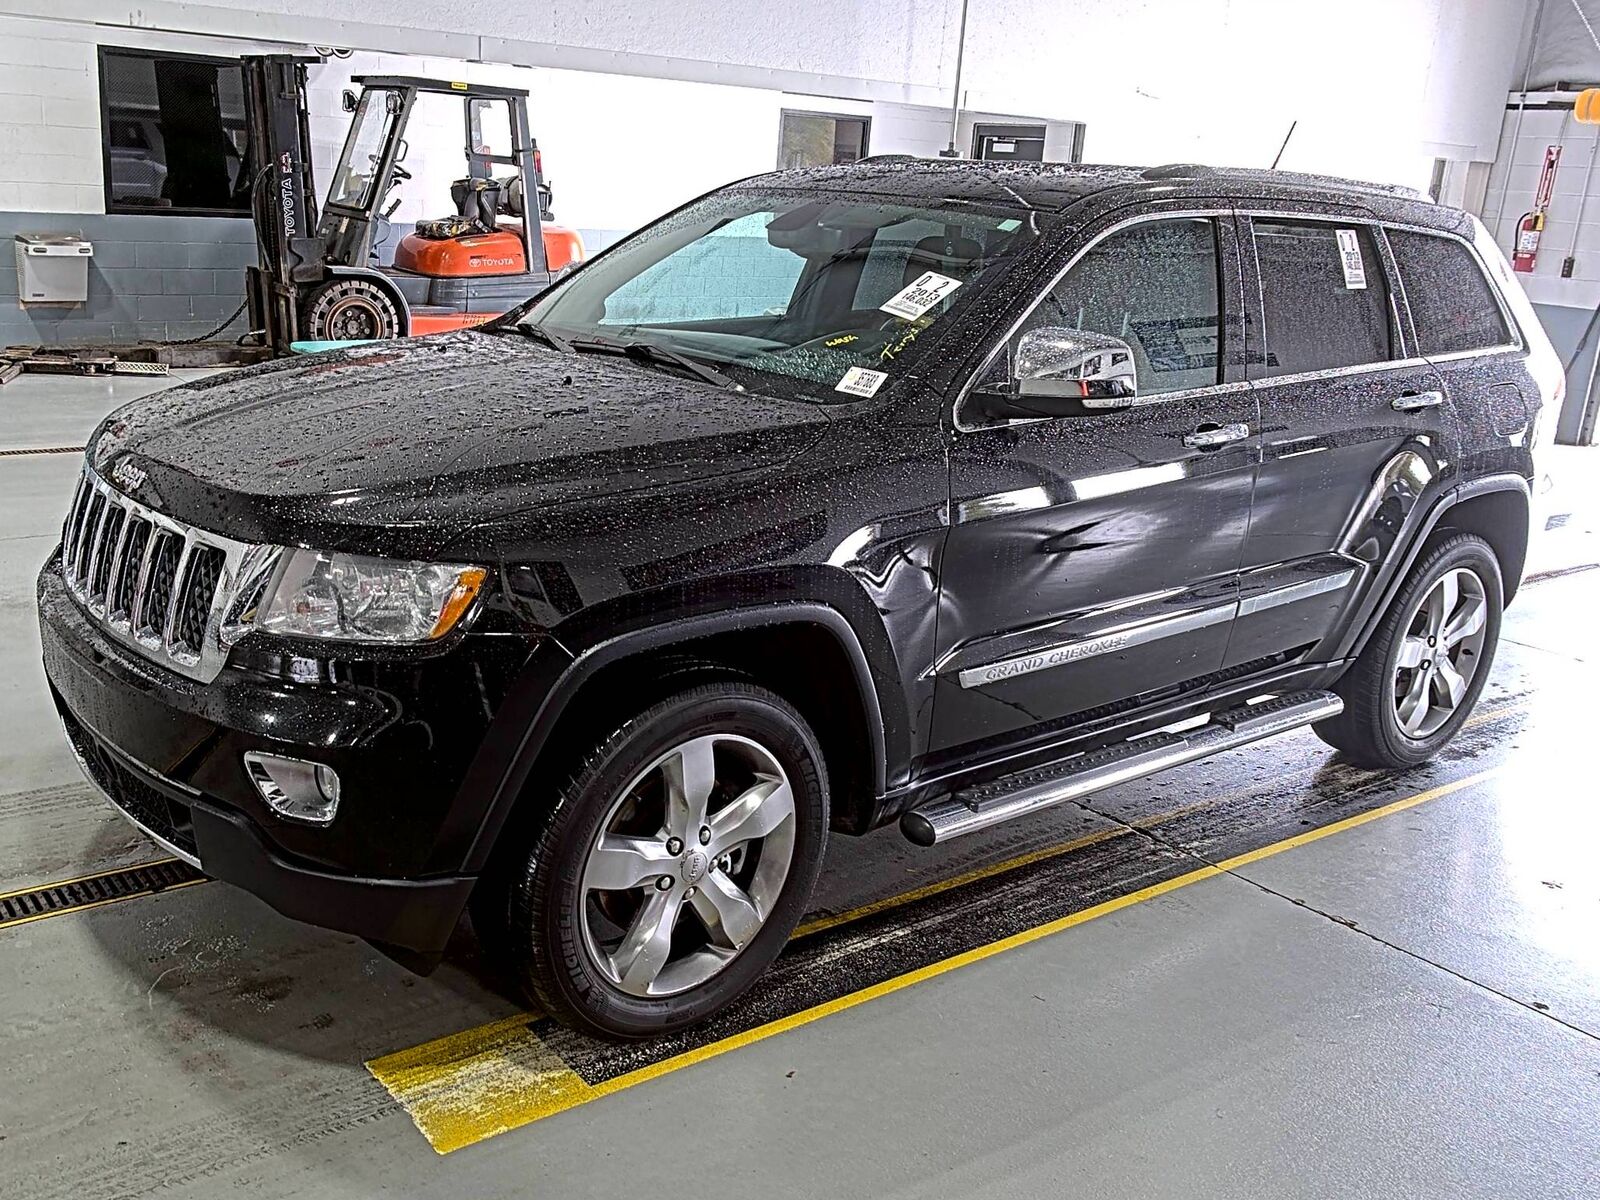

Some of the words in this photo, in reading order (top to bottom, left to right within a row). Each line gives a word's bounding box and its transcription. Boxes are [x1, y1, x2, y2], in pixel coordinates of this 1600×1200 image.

[282, 178, 296, 237] TOYOTA
[482, 258, 514, 267] TOYOTA
[911, 287, 941, 301] 2013
[112, 456, 146, 492] Jeep
[985, 656, 1044, 681] GRAND
[1049, 634, 1128, 664] CHEROKEE
